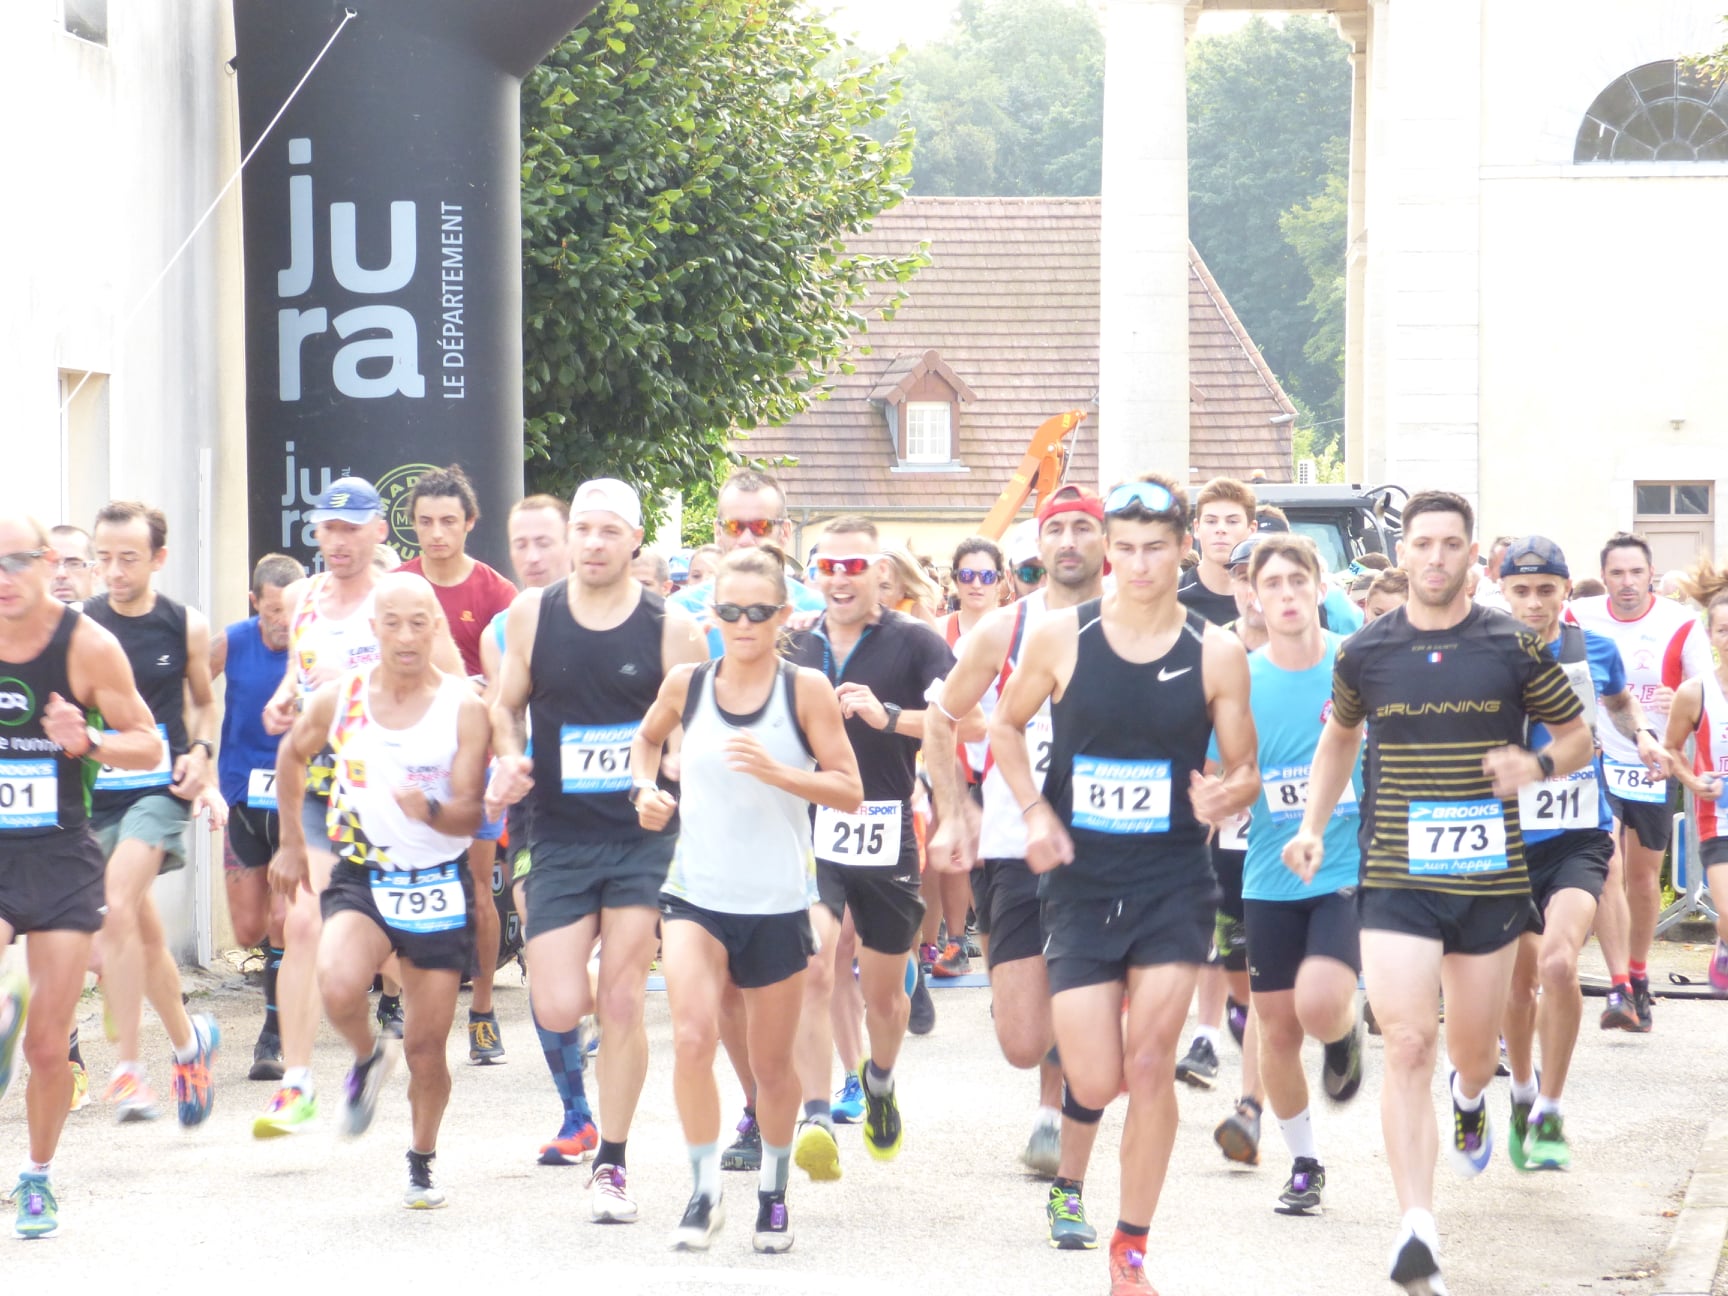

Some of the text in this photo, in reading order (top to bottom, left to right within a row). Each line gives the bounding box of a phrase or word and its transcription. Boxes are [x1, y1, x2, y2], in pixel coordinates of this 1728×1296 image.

[437, 201, 465, 399] LE DÉPARTEMENT
[578, 746, 631, 772] 767
[1094, 763, 1168, 779] BROOKS
[1614, 769, 1654, 788] 784
[1090, 783, 1152, 812] 812
[1536, 787, 1580, 820] 211
[1431, 803, 1500, 820] BROOKS
[832, 821, 885, 855] 215
[1110, 818, 1154, 833] happy
[1425, 824, 1489, 854] 773
[1451, 859, 1492, 871] happy
[388, 888, 447, 915] 793
